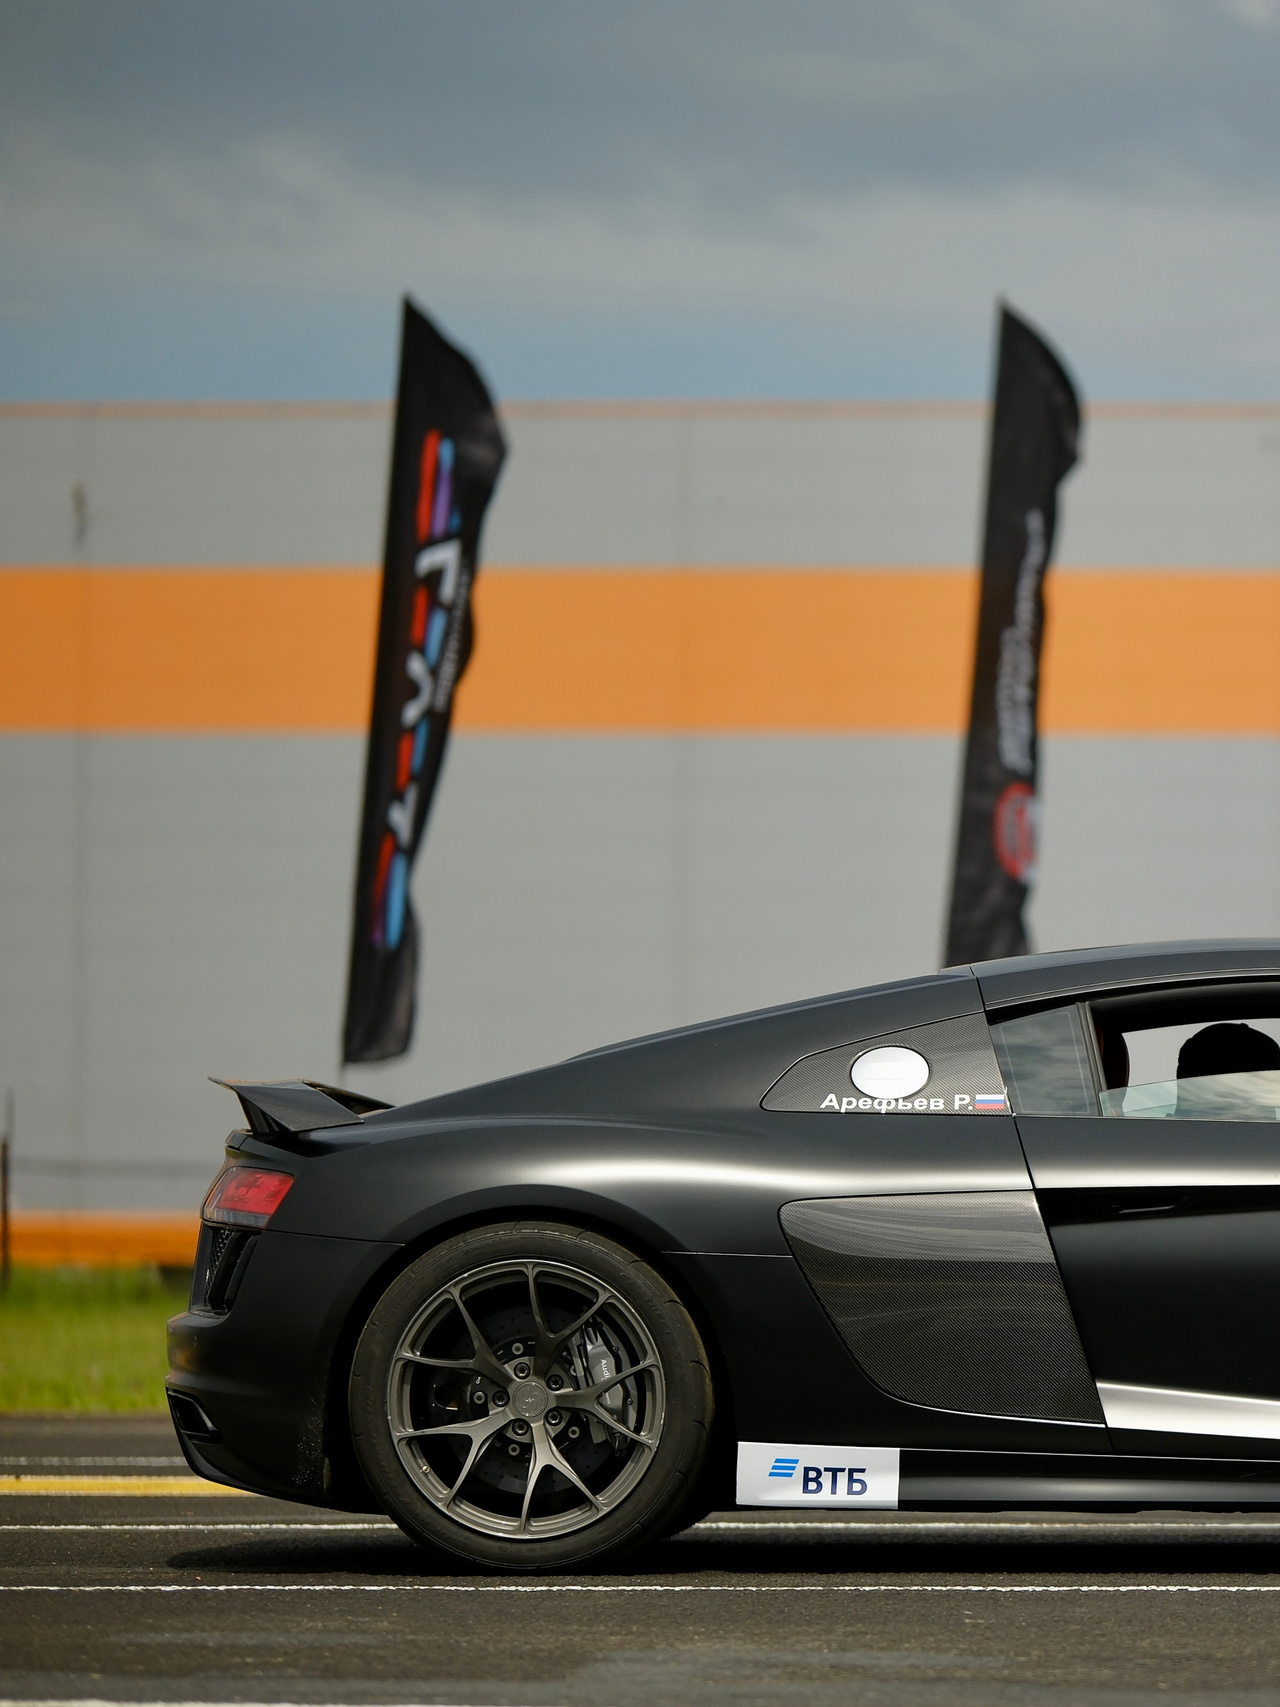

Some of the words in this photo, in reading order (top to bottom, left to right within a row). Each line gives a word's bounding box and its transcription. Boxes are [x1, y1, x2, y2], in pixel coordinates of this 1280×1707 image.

[819, 1093, 944, 1113] Арефьев
[954, 1094, 973, 1110] Р.
[601, 1359, 611, 1378] Audi
[802, 1466, 868, 1496] ВТБ
